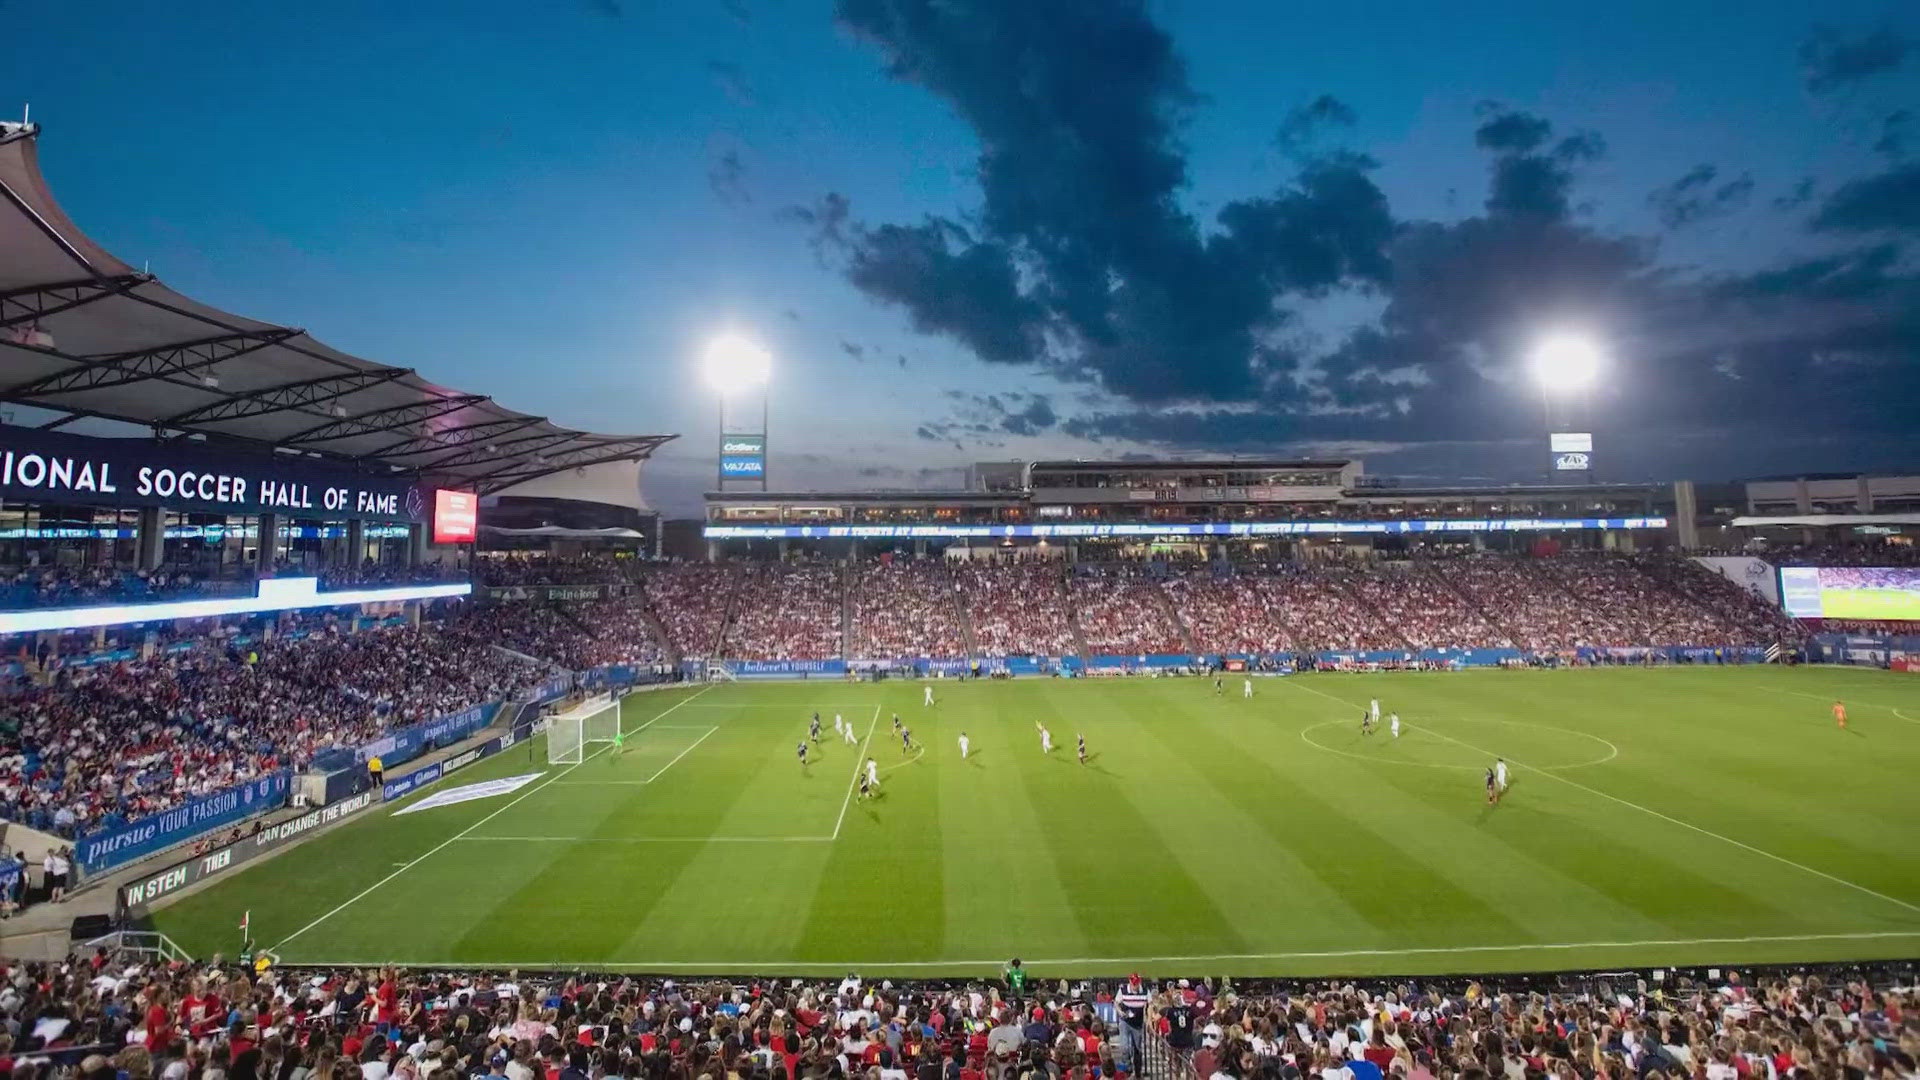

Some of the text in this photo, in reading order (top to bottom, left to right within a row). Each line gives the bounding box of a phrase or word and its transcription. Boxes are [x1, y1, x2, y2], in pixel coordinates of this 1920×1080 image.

[0, 450, 398, 514] IONAL SOCCER HALL OF FAME
[723, 462, 762, 471] VAZATA
[1845, 621, 1887, 630] TOYOTA
[87, 791, 237, 864] pursue YOUR PASSION
[127, 883, 144, 907] IN
[146, 865, 187, 899] STEM
[256, 826, 279, 847] CAN
[280, 809, 321, 839] CHANGE
[322, 803, 339, 824] THE
[340, 792, 371, 816] WORLD
